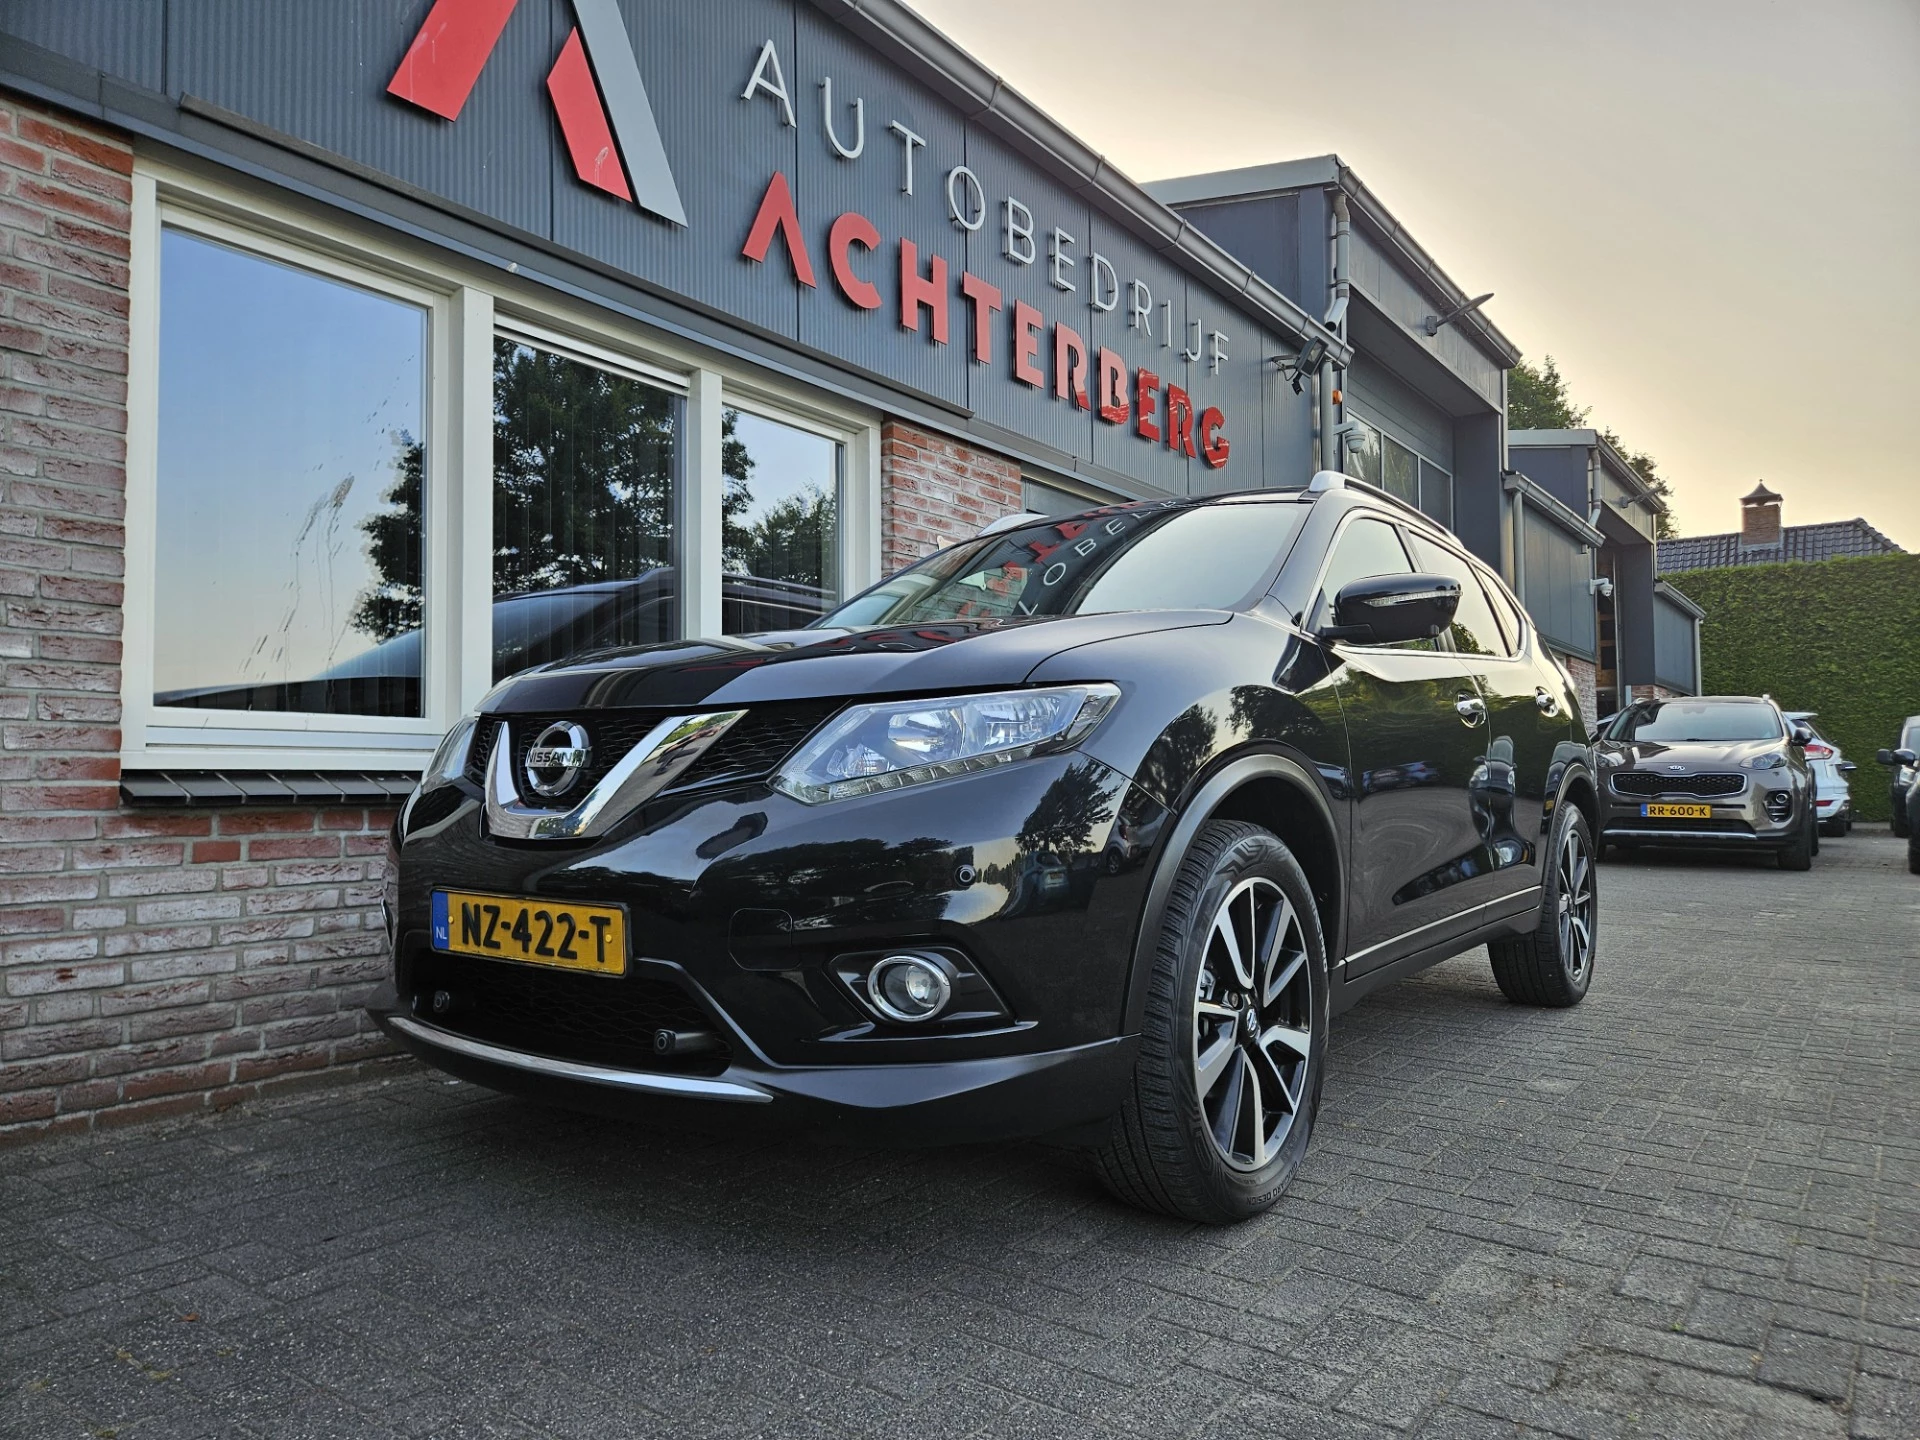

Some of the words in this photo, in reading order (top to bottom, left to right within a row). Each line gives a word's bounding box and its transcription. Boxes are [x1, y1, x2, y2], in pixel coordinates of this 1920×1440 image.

[741, 39, 1230, 375] AUTOBEDRIJF
[742, 171, 1230, 469] ACHTERBERG
[527, 751, 573, 763] NISSAN
[1649, 805, 1707, 816] RR-600-K
[435, 926, 448, 940] NL
[461, 901, 612, 964] NZ-422-T
